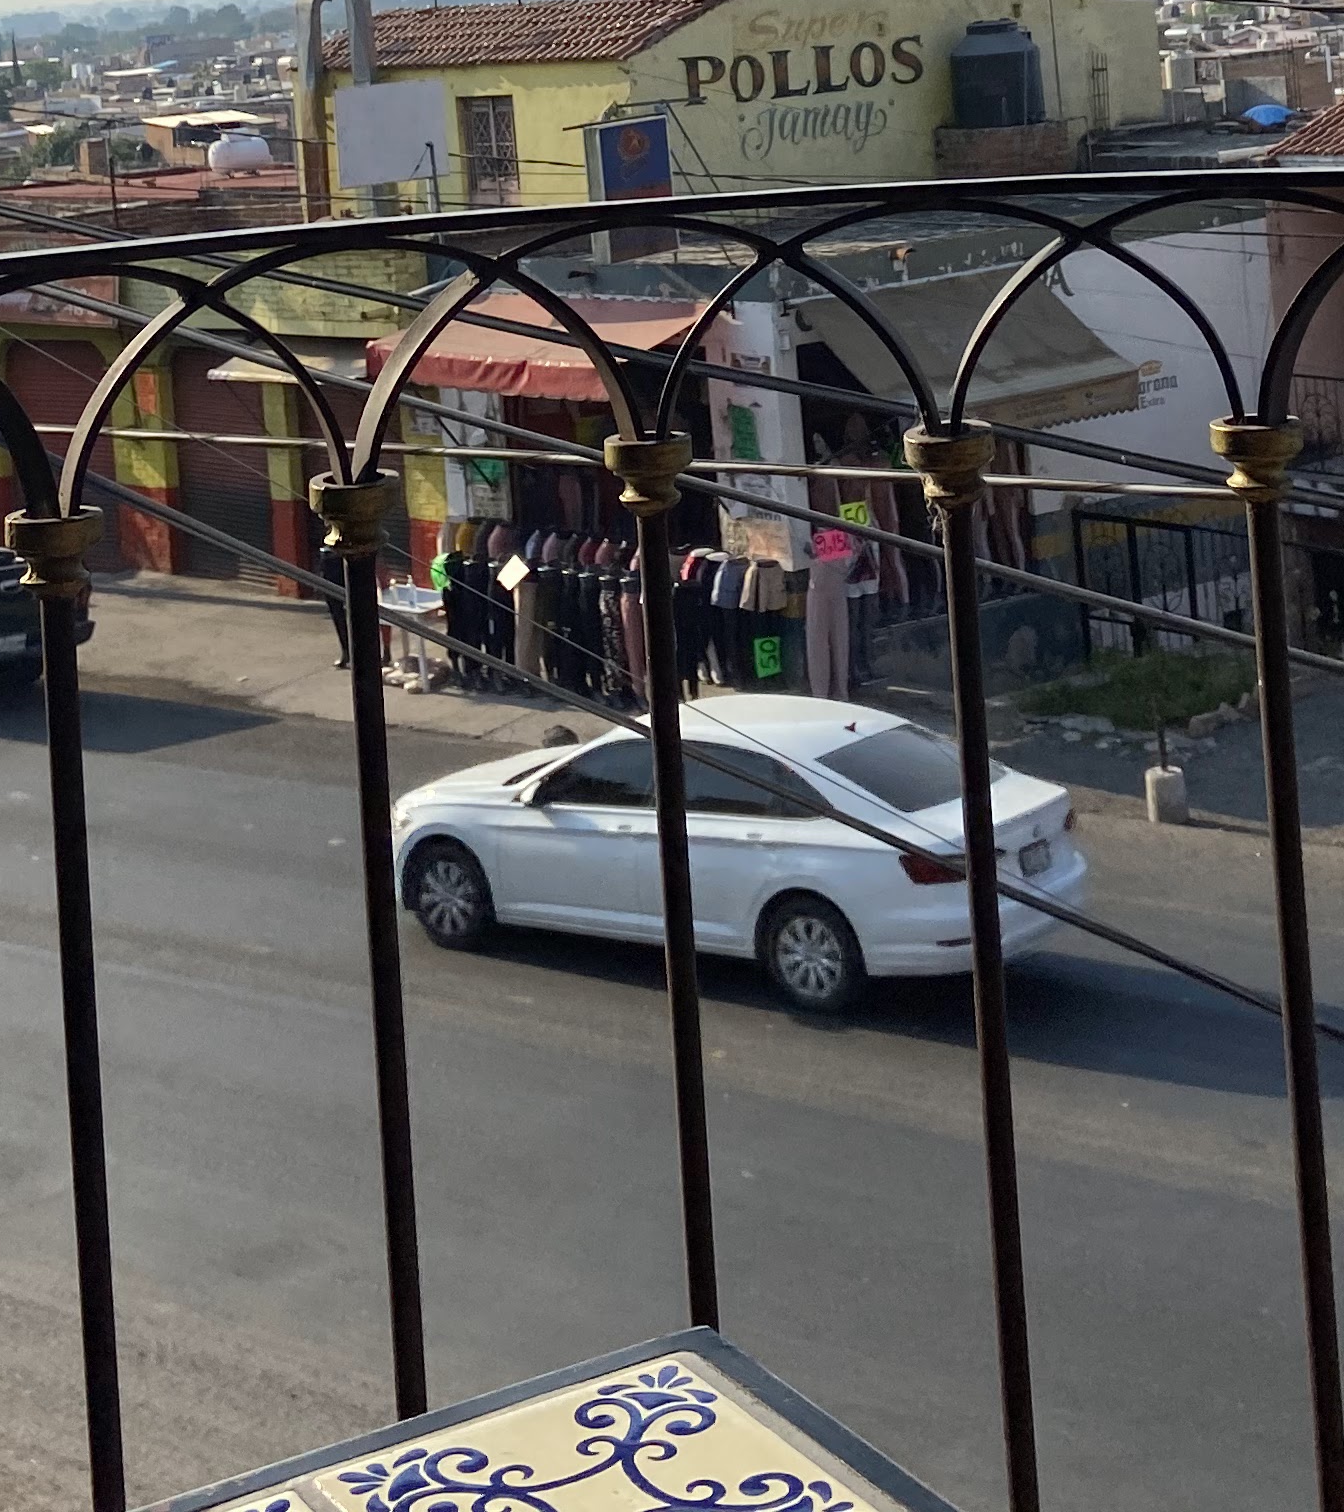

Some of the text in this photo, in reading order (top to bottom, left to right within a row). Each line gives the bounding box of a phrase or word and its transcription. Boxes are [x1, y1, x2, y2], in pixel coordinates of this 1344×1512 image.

[678, 34, 924, 106] POLLOS
[1139, 374, 1179, 395] orona
[843, 504, 868, 526] 50
[759, 639, 778, 669] 50
